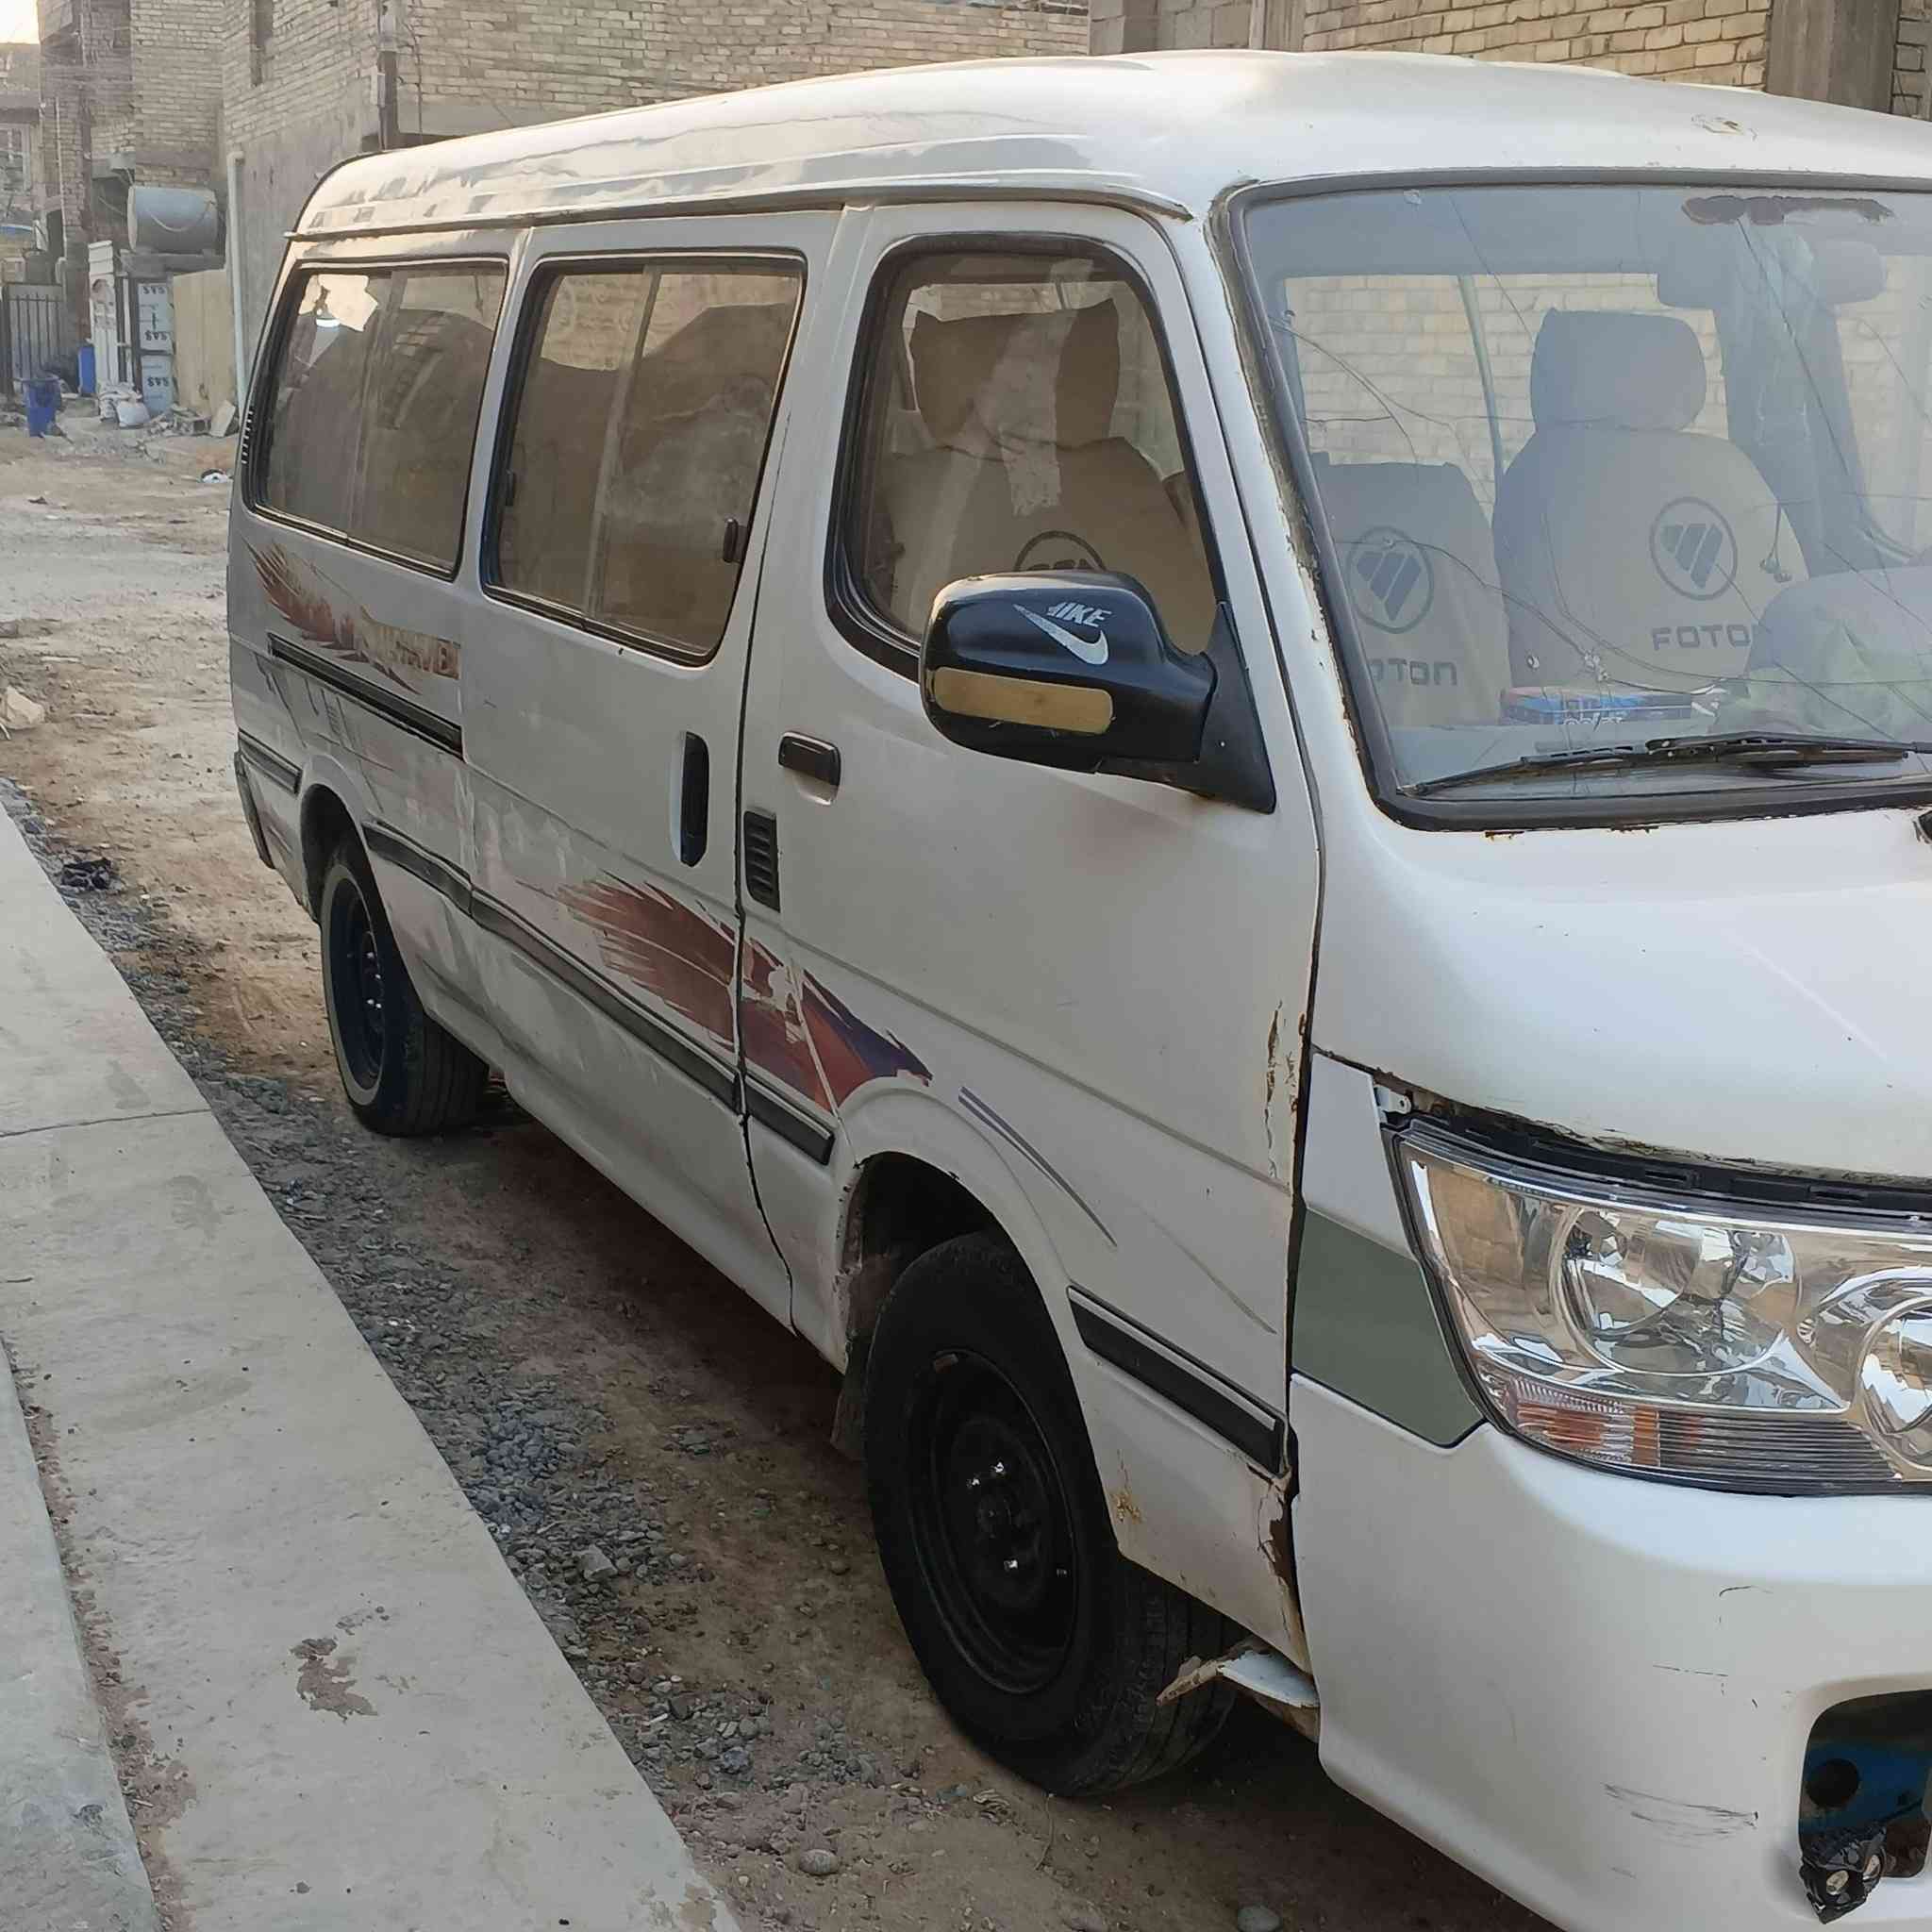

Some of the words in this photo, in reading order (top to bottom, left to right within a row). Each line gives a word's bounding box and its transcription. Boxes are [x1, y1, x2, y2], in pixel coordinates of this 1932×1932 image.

[144, 330, 168, 341] SAS
[147, 376, 170, 387] SAS
[1652, 625, 1753, 651] FOTO
[1369, 657, 1457, 687] OTON
